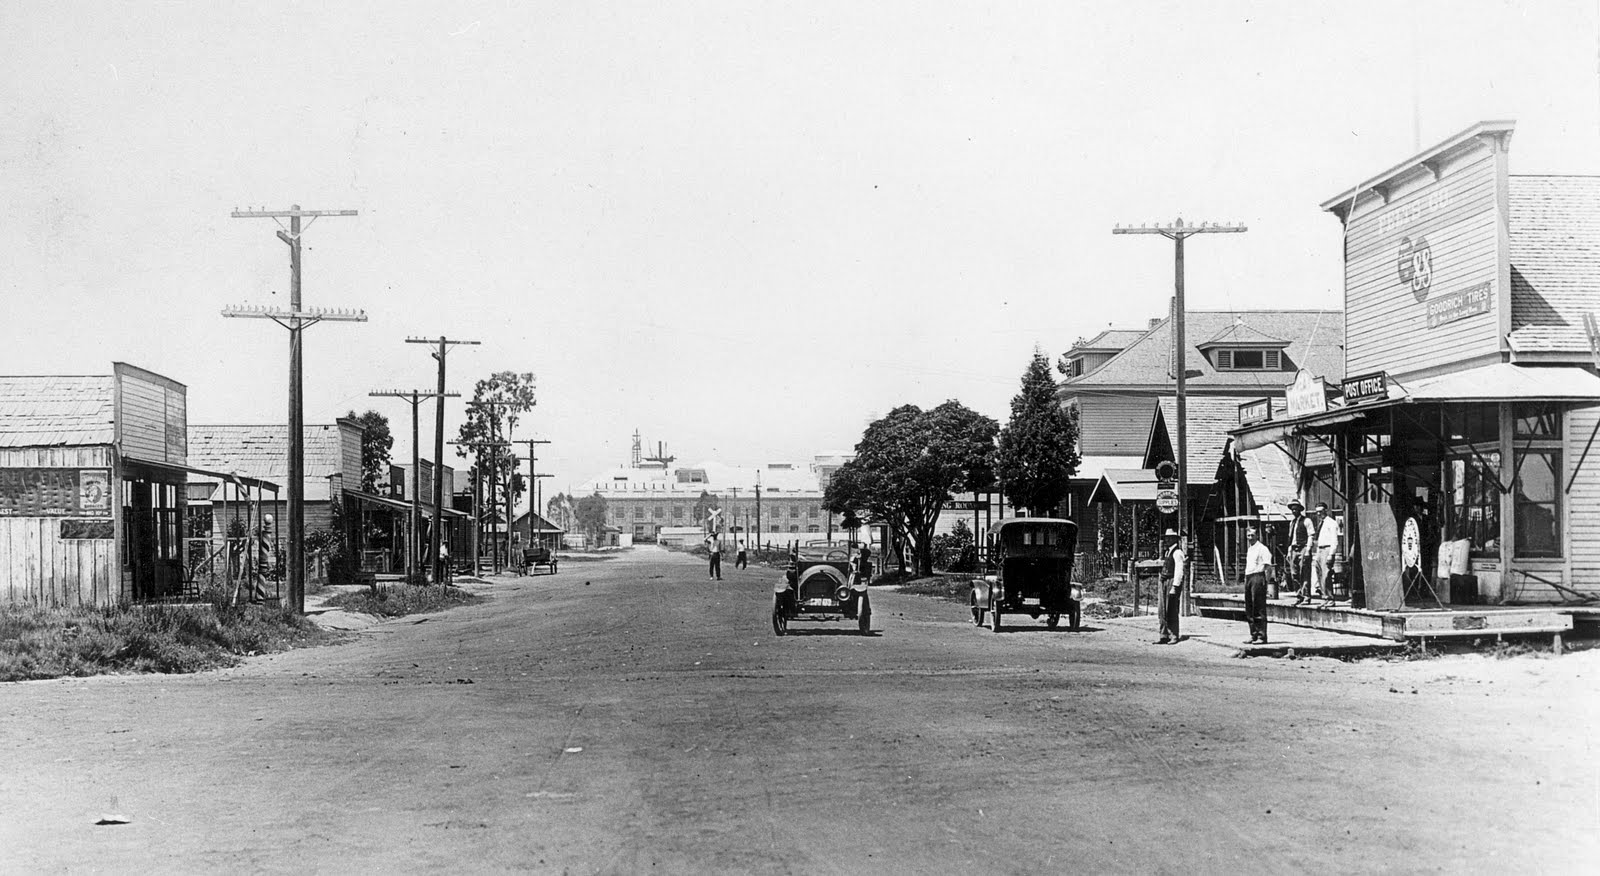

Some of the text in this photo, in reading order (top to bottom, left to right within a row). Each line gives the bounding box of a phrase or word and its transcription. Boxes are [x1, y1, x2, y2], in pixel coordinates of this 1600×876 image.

[1430, 287, 1489, 315] GOODRICH TIRES
[1344, 380, 1360, 398] POST
